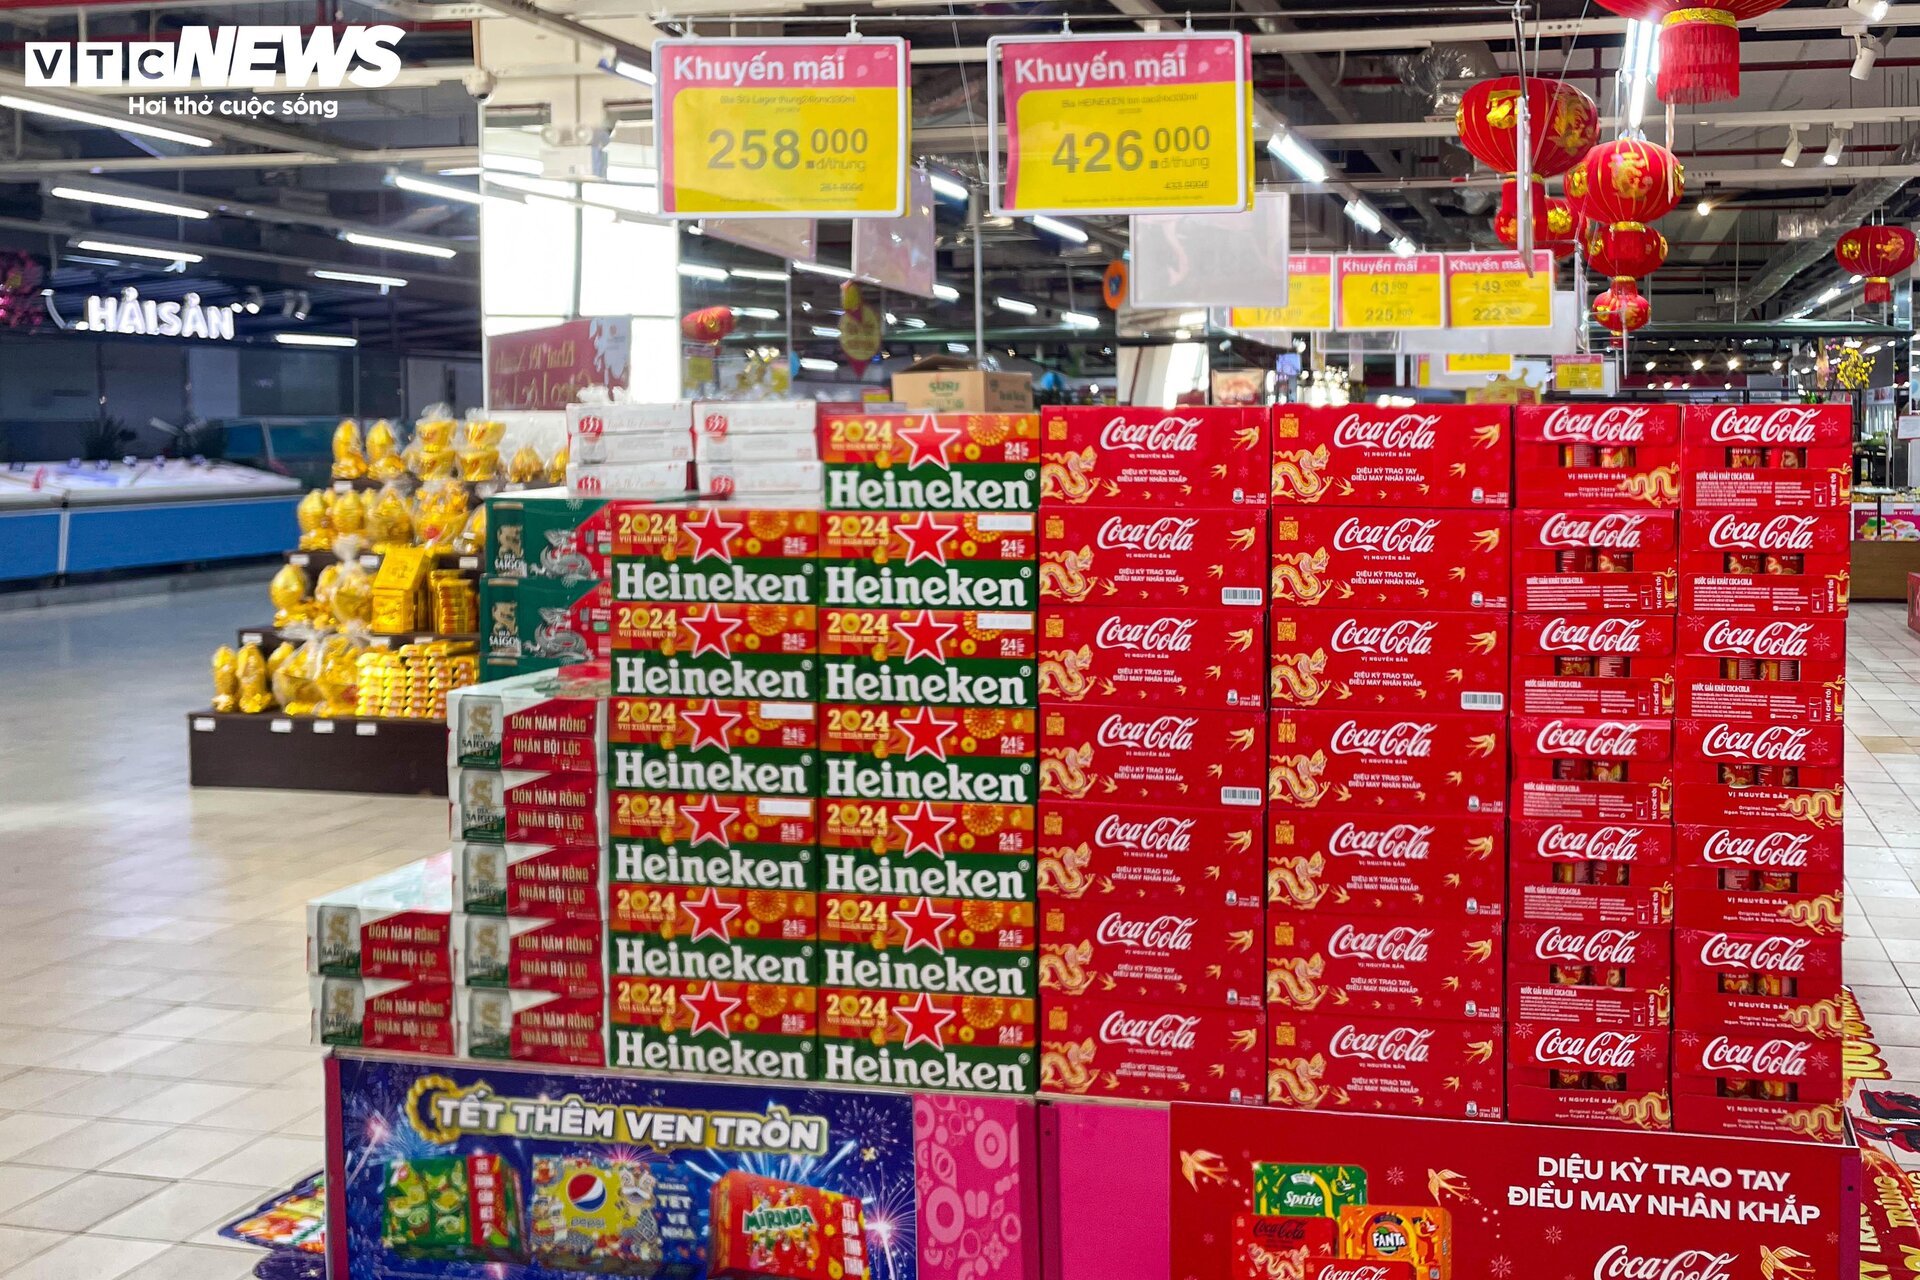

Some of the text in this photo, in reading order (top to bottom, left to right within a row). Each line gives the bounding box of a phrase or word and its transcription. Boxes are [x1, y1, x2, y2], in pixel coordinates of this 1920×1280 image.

[674, 51, 845, 87] Khuyến mãi
[1015, 50, 1187, 88] Khuyến mãi
[1342, 259, 1391, 275] Khuyến
[1450, 257, 1498, 273] Khuyến
[830, 420, 892, 443] 2024
[619, 513, 677, 535] 2024
[827, 515, 889, 537] 2024
[618, 607, 676, 630] 2024
[827, 612, 889, 634] 2024
[617, 701, 676, 723] 2024
[827, 708, 889, 732] 2024
[617, 794, 675, 817] 2024
[827, 803, 888, 828] 2024
[617, 889, 675, 912] 2024
[827, 899, 888, 923] 2024
[618, 981, 675, 1005] 2024
[827, 994, 888, 1018] 2024
[437, 1089, 820, 1150] TẾT THÊM VẸN TRÒN
[1538, 1153, 1791, 1192] DIỆU KỲ TRAO TAY
[1283, 1191, 1323, 1207] Sprite
[1507, 1180, 1820, 1226] ĐIỀU MAY NHÂN KHẮP
[1373, 1232, 1408, 1249] FANTA
